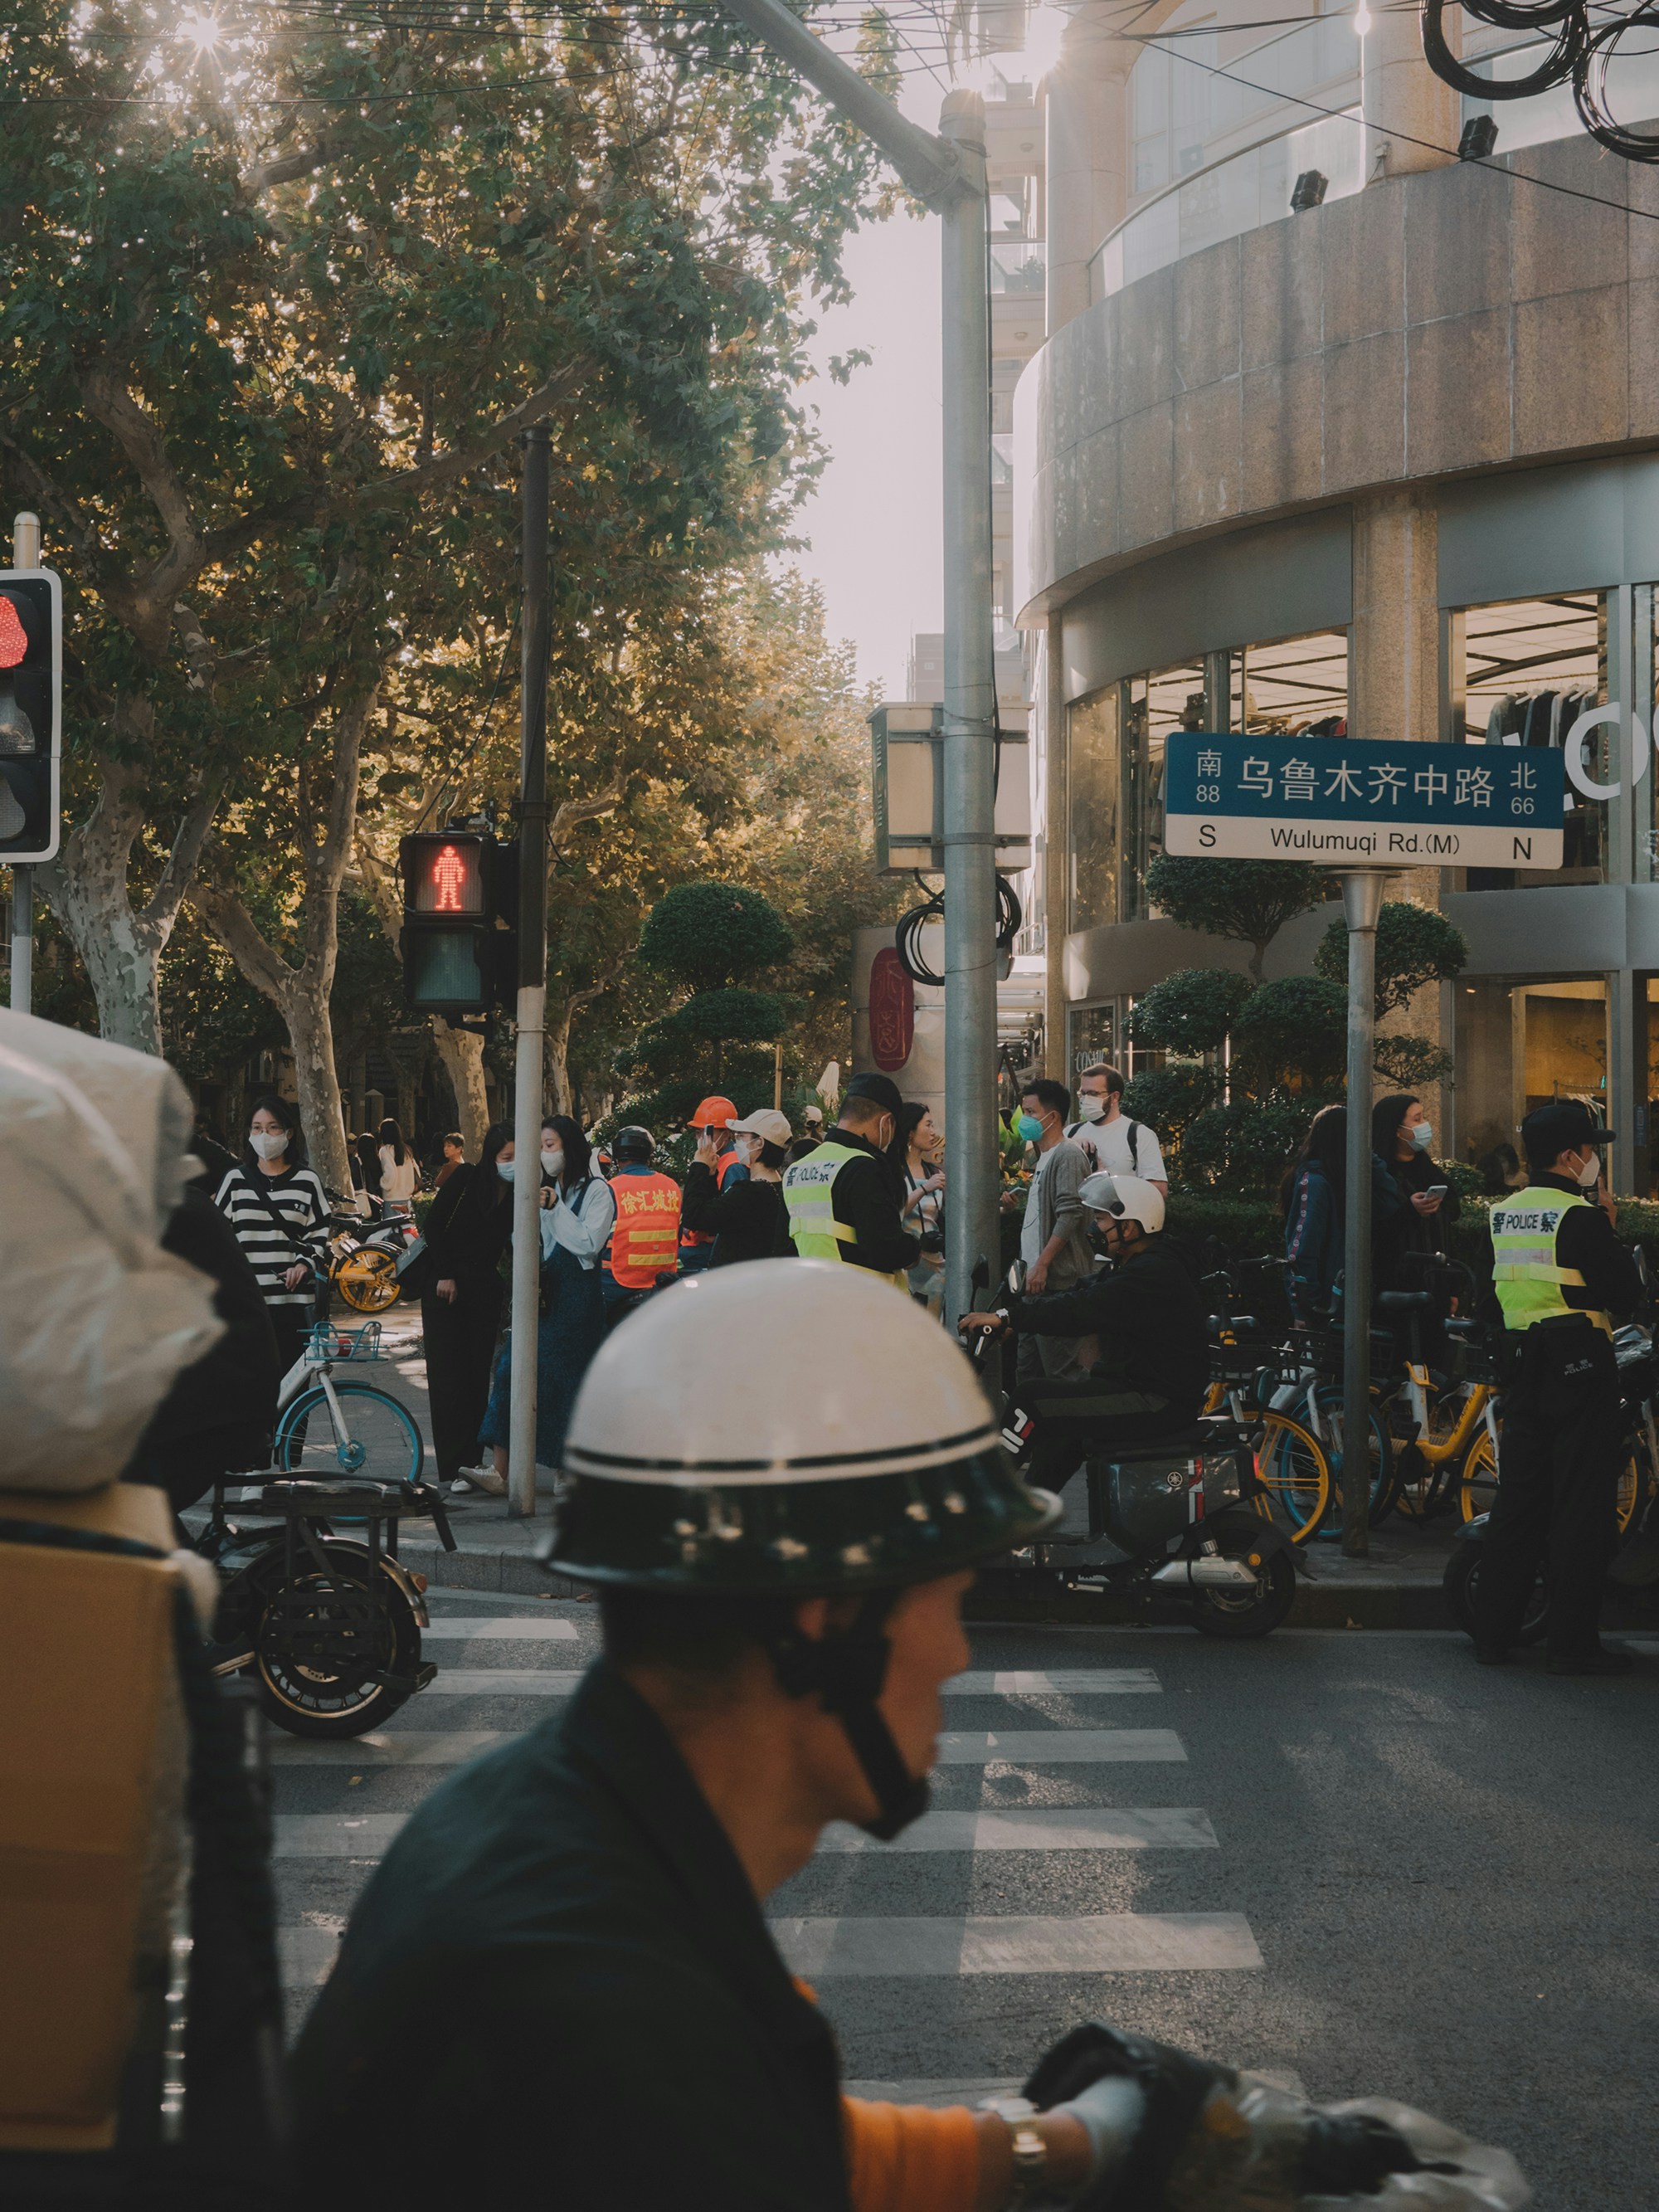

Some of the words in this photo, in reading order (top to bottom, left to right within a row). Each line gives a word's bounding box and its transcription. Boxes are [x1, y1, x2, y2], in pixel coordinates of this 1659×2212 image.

[1197, 748, 1222, 777] 南
[1237, 755, 1495, 808] 乌鲁木齐中路
[1510, 762, 1537, 789] 北
[1196, 784, 1220, 803] 88
[1511, 797, 1535, 815] 66
[1199, 824, 1217, 848] S
[1270, 828, 1376, 856] Wulumuqi
[1513, 836, 1532, 860] N
[620, 1189, 679, 1214] 徐汇城投
[1492, 1212, 1506, 1234] 警
[1506, 1214, 1540, 1230] POLICE
[1540, 1211, 1558, 1232] 察
